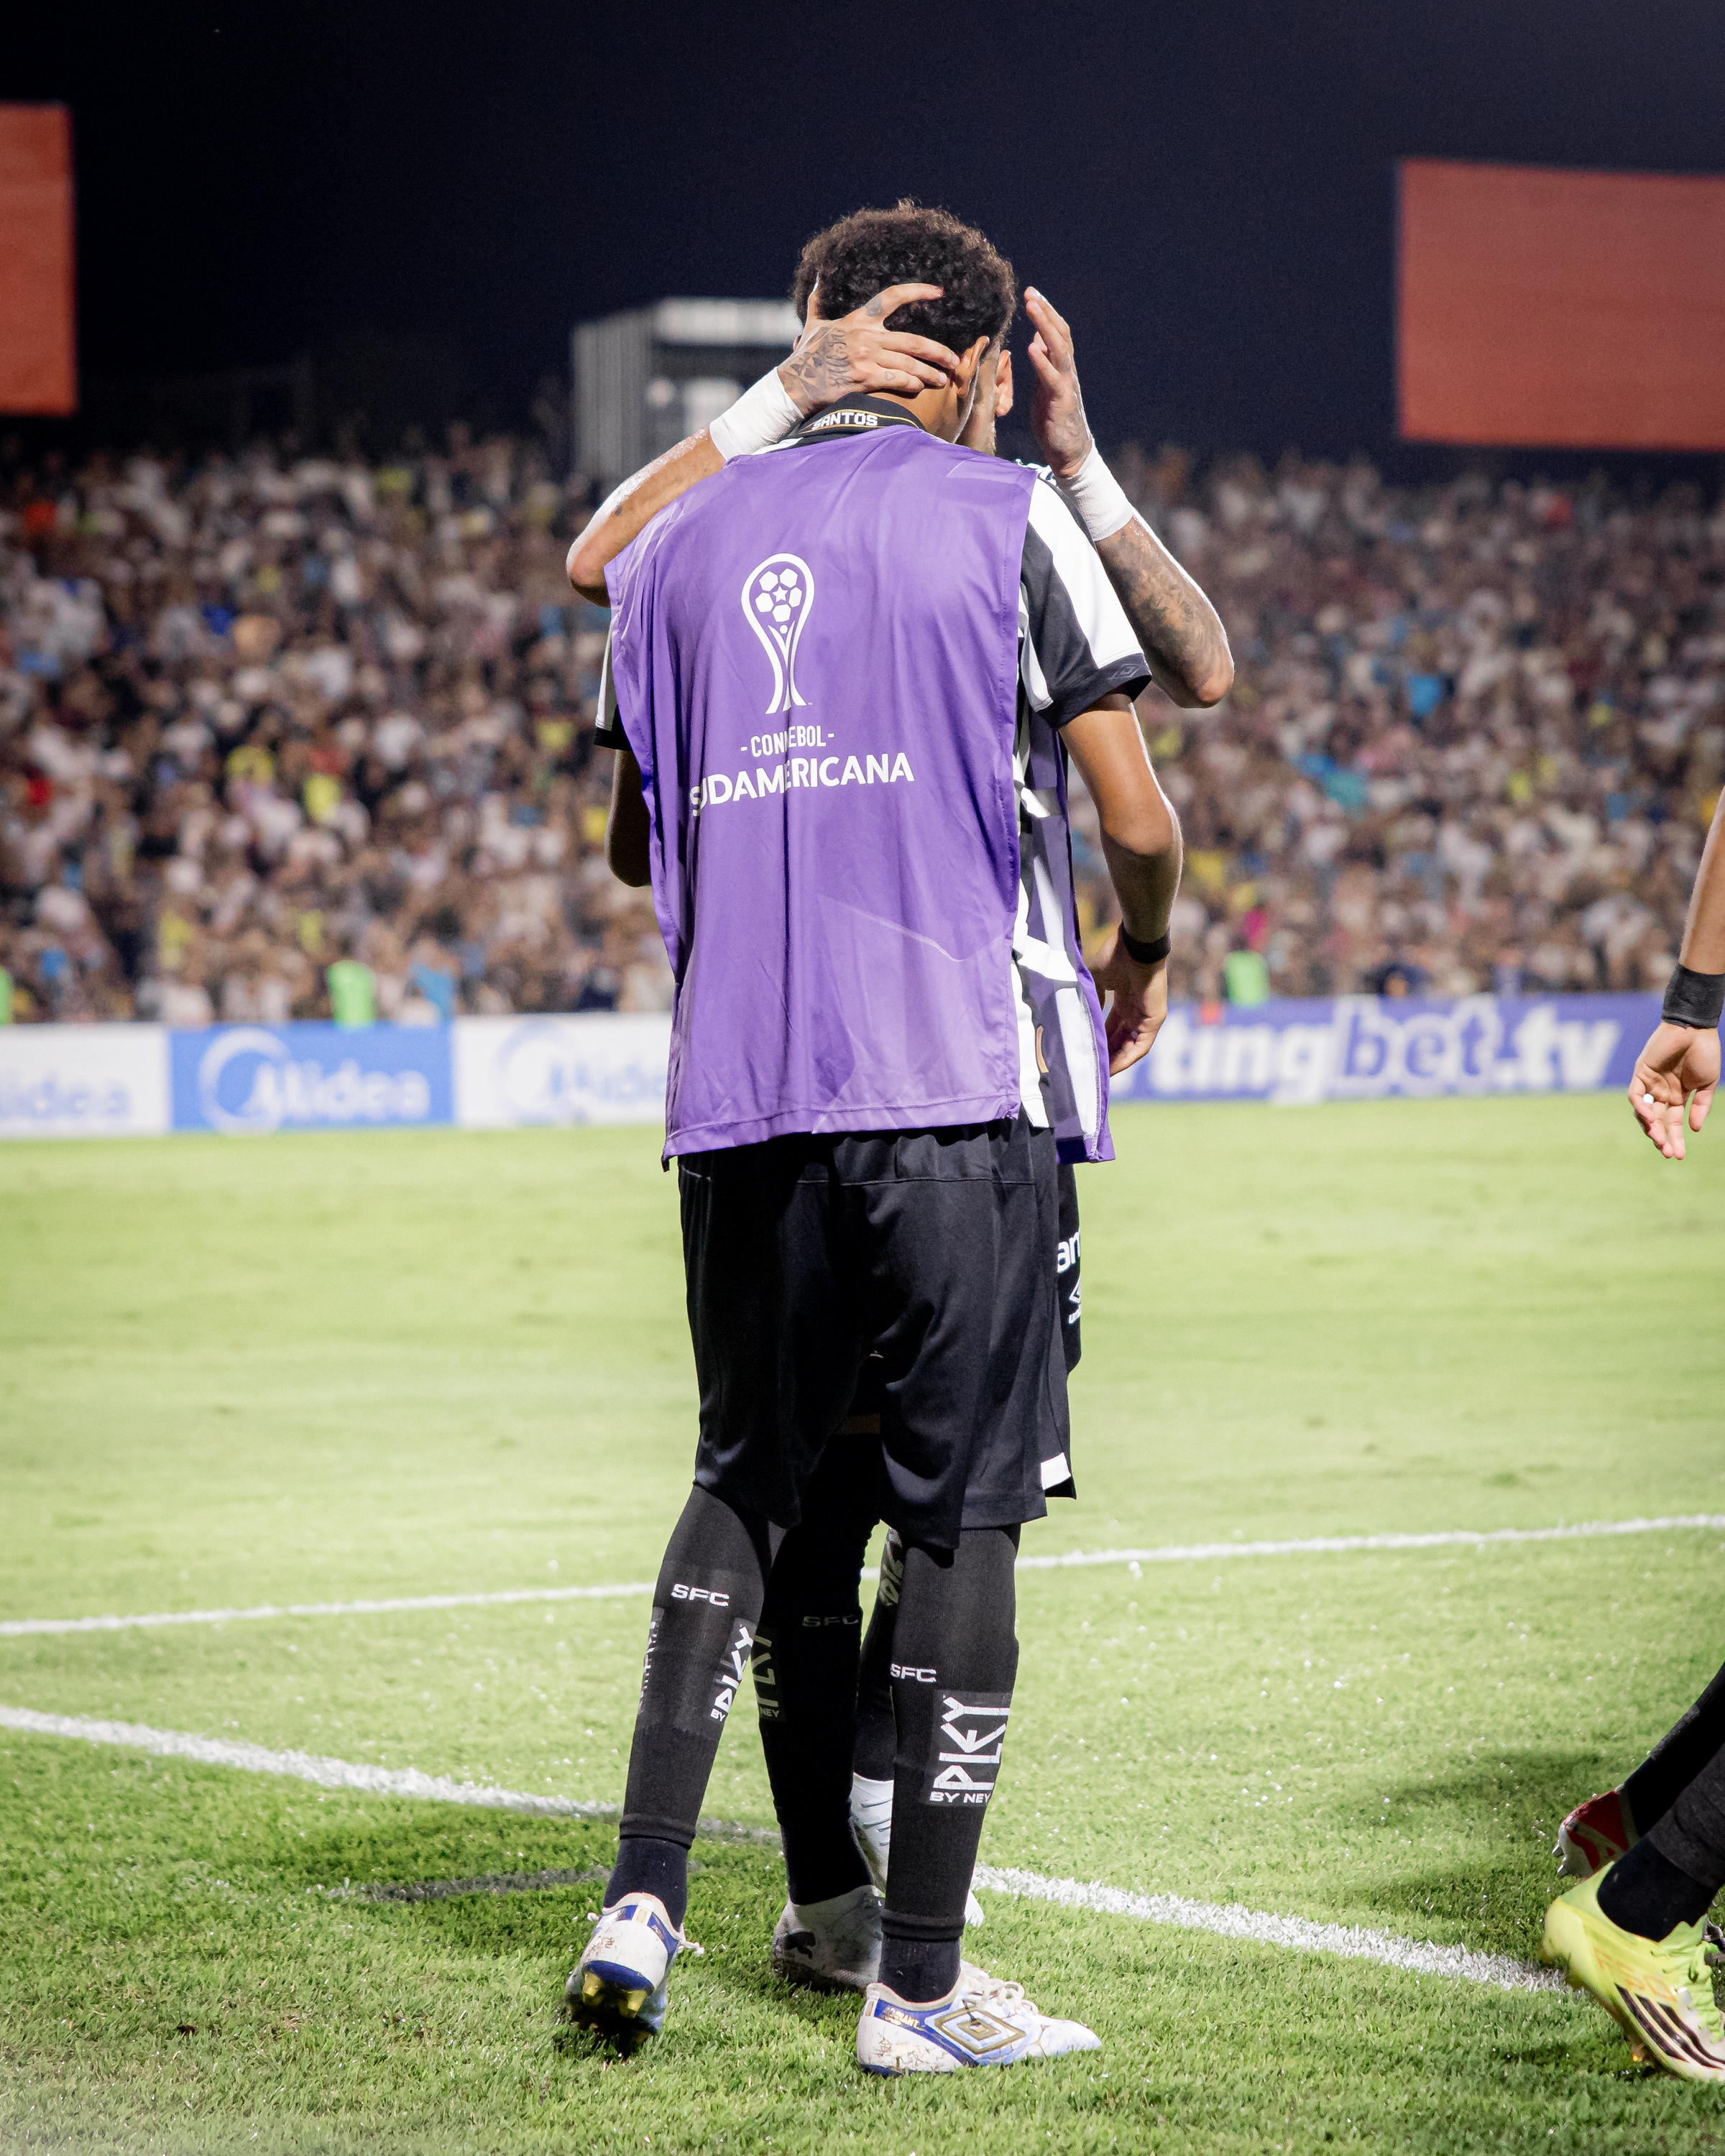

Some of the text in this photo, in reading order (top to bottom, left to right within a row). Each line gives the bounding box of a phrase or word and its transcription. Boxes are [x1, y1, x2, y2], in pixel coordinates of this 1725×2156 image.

[811, 412, 878, 430] SANTOS
[671, 1583, 730, 1607] SFC
[891, 1663, 937, 1682] SFC
[930, 1791, 991, 1804] BY NEY
